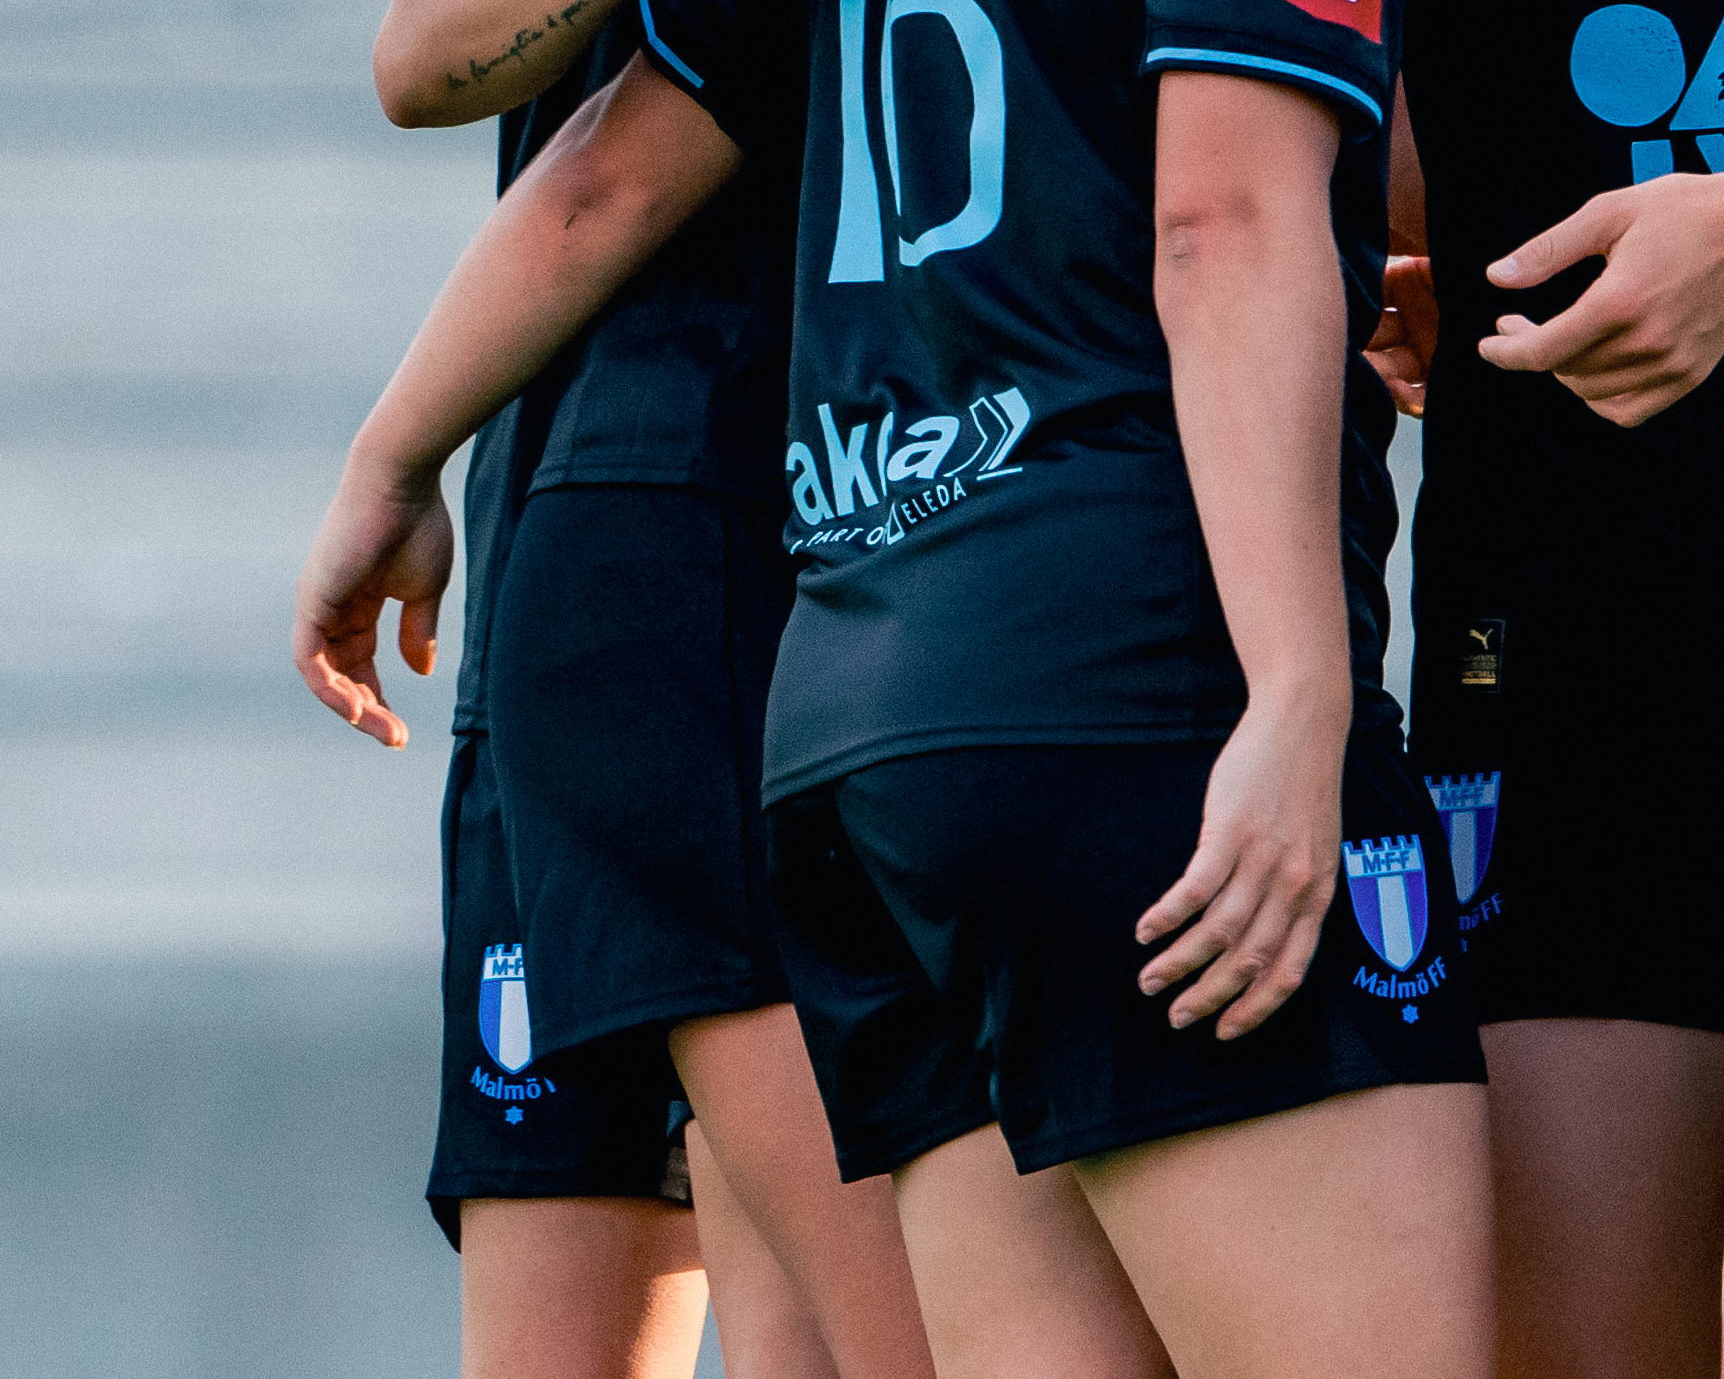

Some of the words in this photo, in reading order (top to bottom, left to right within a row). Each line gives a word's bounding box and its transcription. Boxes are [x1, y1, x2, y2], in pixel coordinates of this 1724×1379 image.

[806, 527, 864, 548] PART
[900, 477, 967, 525] ELEDA
[1353, 965, 1430, 999] Malmö
[1427, 956, 1447, 988] FF
[470, 1066, 542, 1100] Malmö
